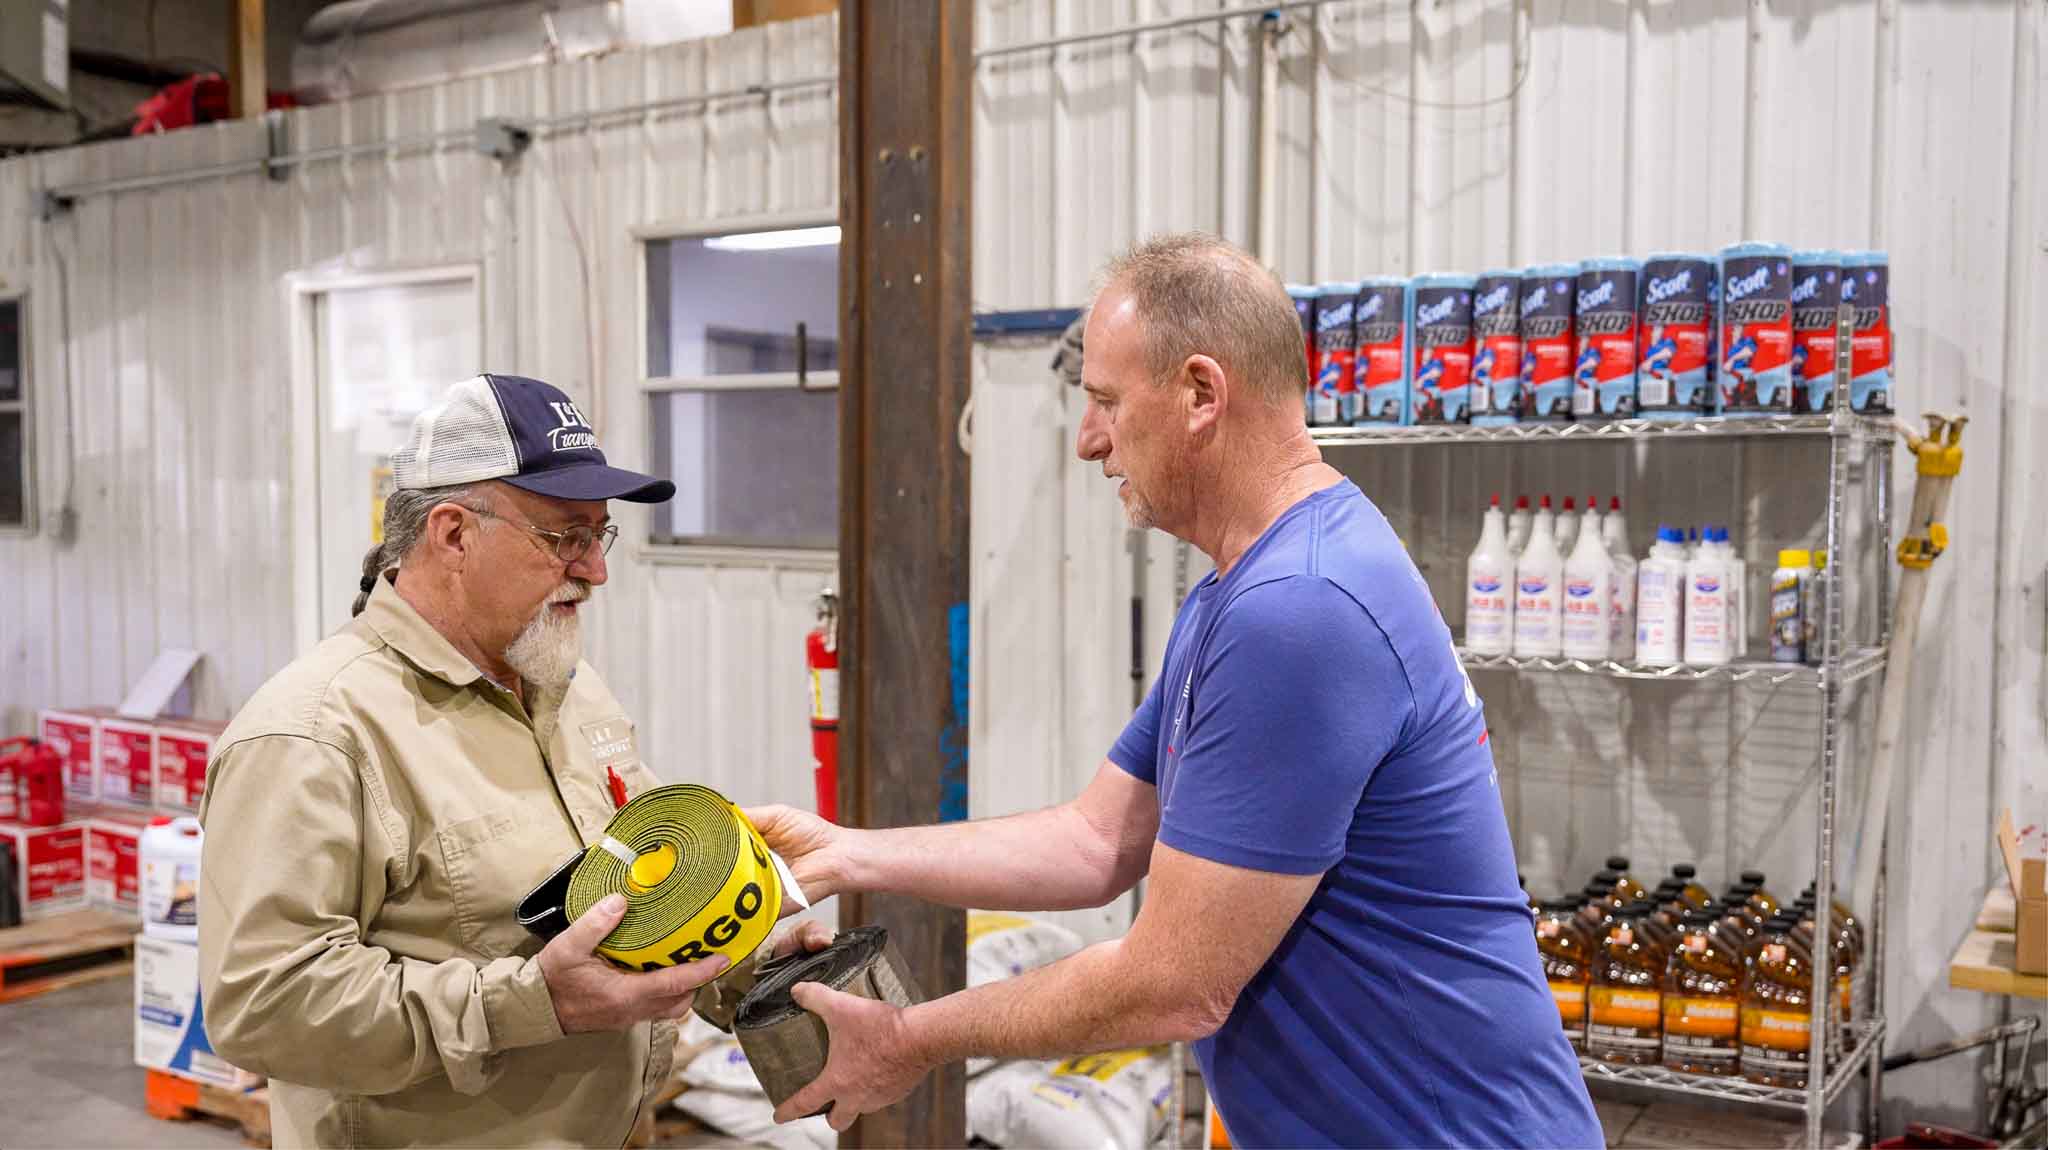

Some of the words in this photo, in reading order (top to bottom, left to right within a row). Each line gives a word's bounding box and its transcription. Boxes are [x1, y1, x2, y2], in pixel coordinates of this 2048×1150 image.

[1646, 270, 1691, 304] Scott
[1726, 266, 1770, 303] Scott
[1792, 274, 1818, 302] ott
[1577, 280, 1613, 316] Scott
[1577, 313, 1631, 334] SHOP
[1647, 302, 1705, 322] SHOP
[1728, 302, 1786, 321] SHOP
[1793, 308, 1837, 328] HOP
